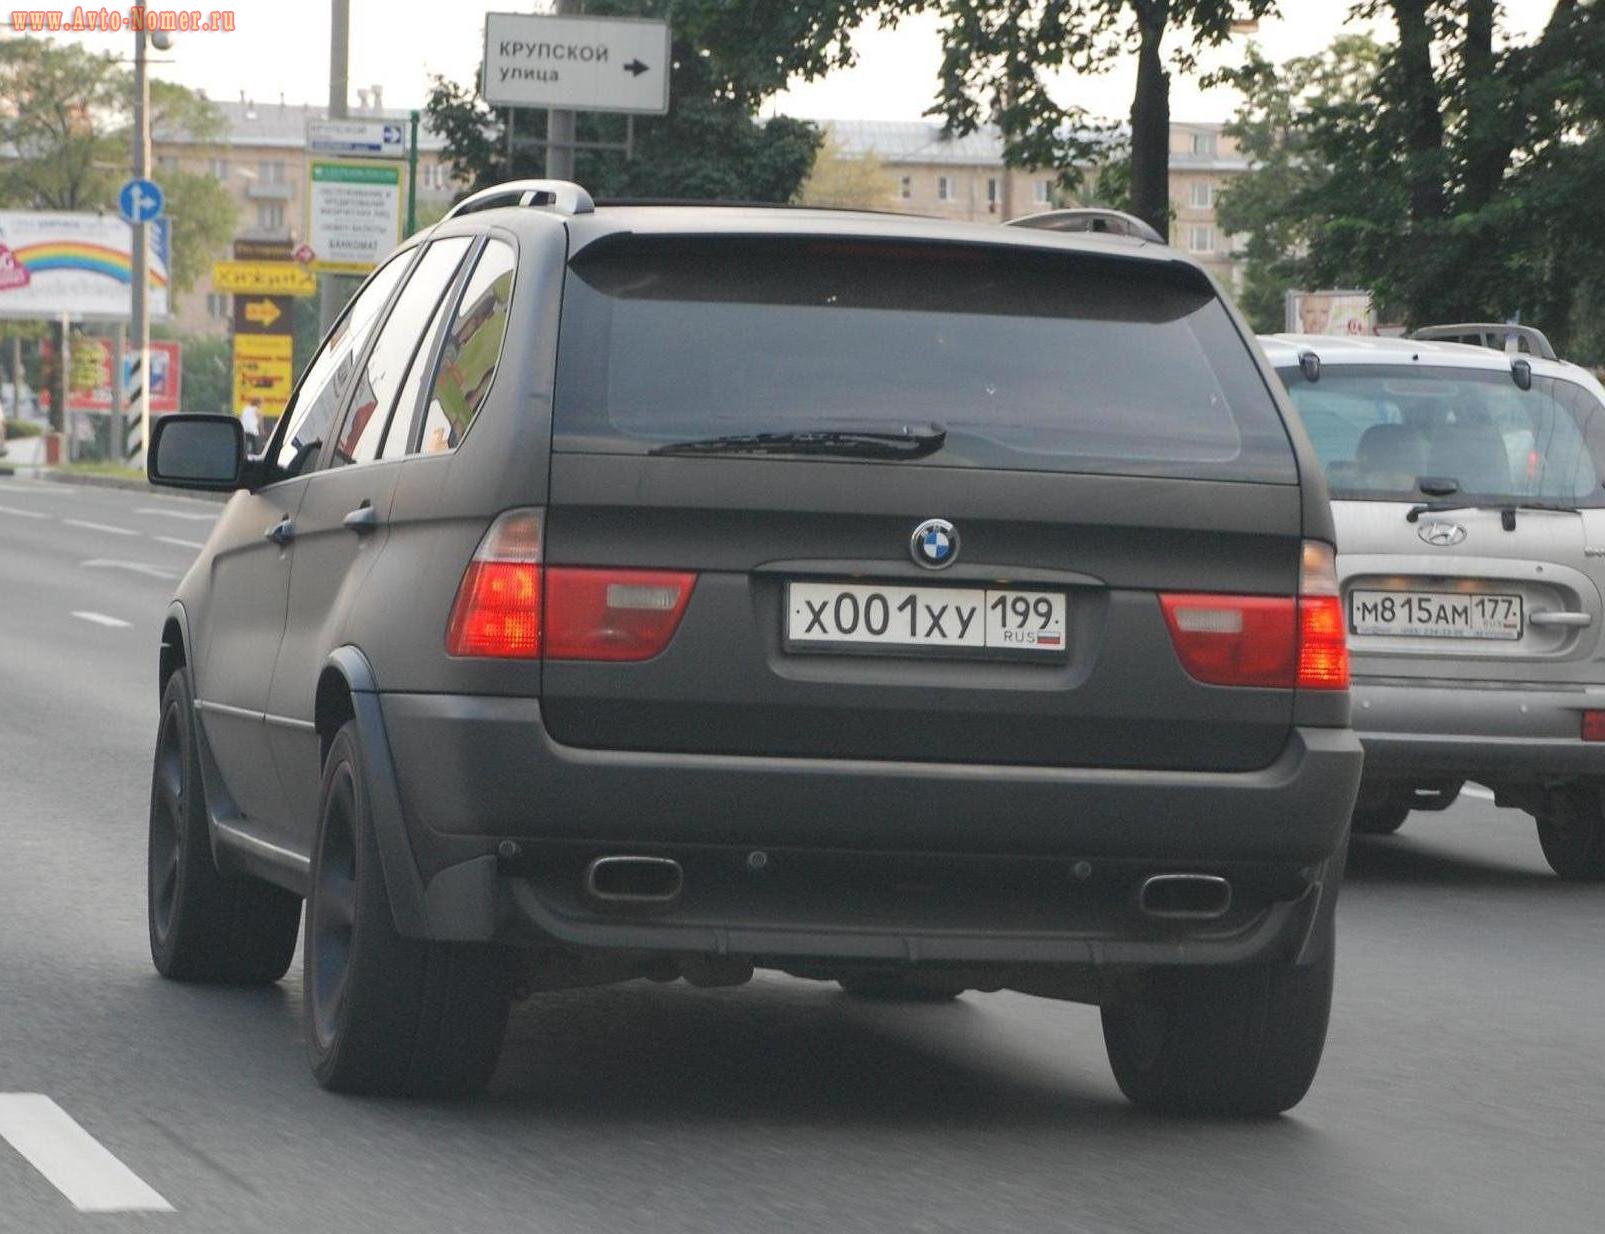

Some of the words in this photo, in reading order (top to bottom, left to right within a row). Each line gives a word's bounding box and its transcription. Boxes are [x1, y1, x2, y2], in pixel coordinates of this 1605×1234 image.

[500, 41, 609, 62] КРУПСКОЙ
[500, 66, 559, 82] улица
[990, 595, 1054, 630] 199
[1361, 597, 1469, 625] М815АМ
[1475, 598, 1513, 620] 177
[1003, 630, 1036, 645] RUS
